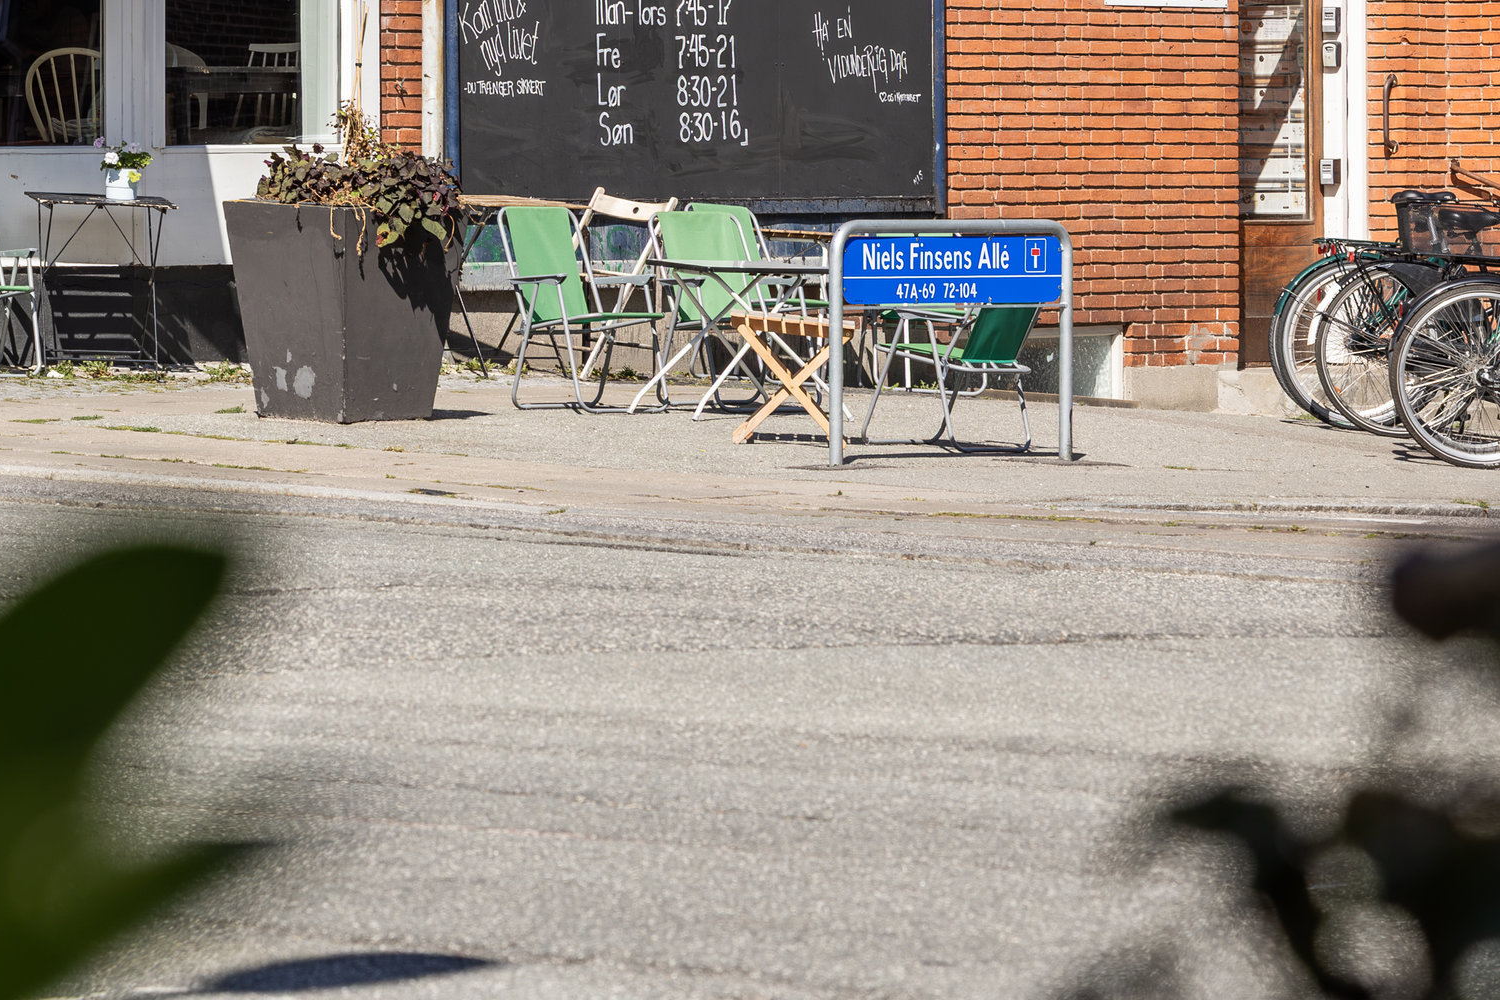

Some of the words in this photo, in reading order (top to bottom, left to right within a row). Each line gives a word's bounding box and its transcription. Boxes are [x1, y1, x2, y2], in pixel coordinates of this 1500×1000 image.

[458, 0, 494, 44] Kom
[480, 24, 507, 77] nyd
[507, 20, 540, 65] livet
[596, 32, 621, 69] Fre
[674, 33, 736, 70] 7:45-21
[889, 48, 908, 83] DAG
[516, 78, 546, 97] SIKKERT
[597, 72, 627, 108] Lør
[676, 73, 738, 111] 8:30-21
[598, 111, 634, 147] Søn
[679, 109, 741, 143] 8:30-16
[862, 242, 905, 271] Niels
[909, 242, 972, 270] Finsens
[977, 242, 1010, 270] Allé
[894, 281, 937, 300] 47A-69
[942, 281, 979, 300] 72-104
